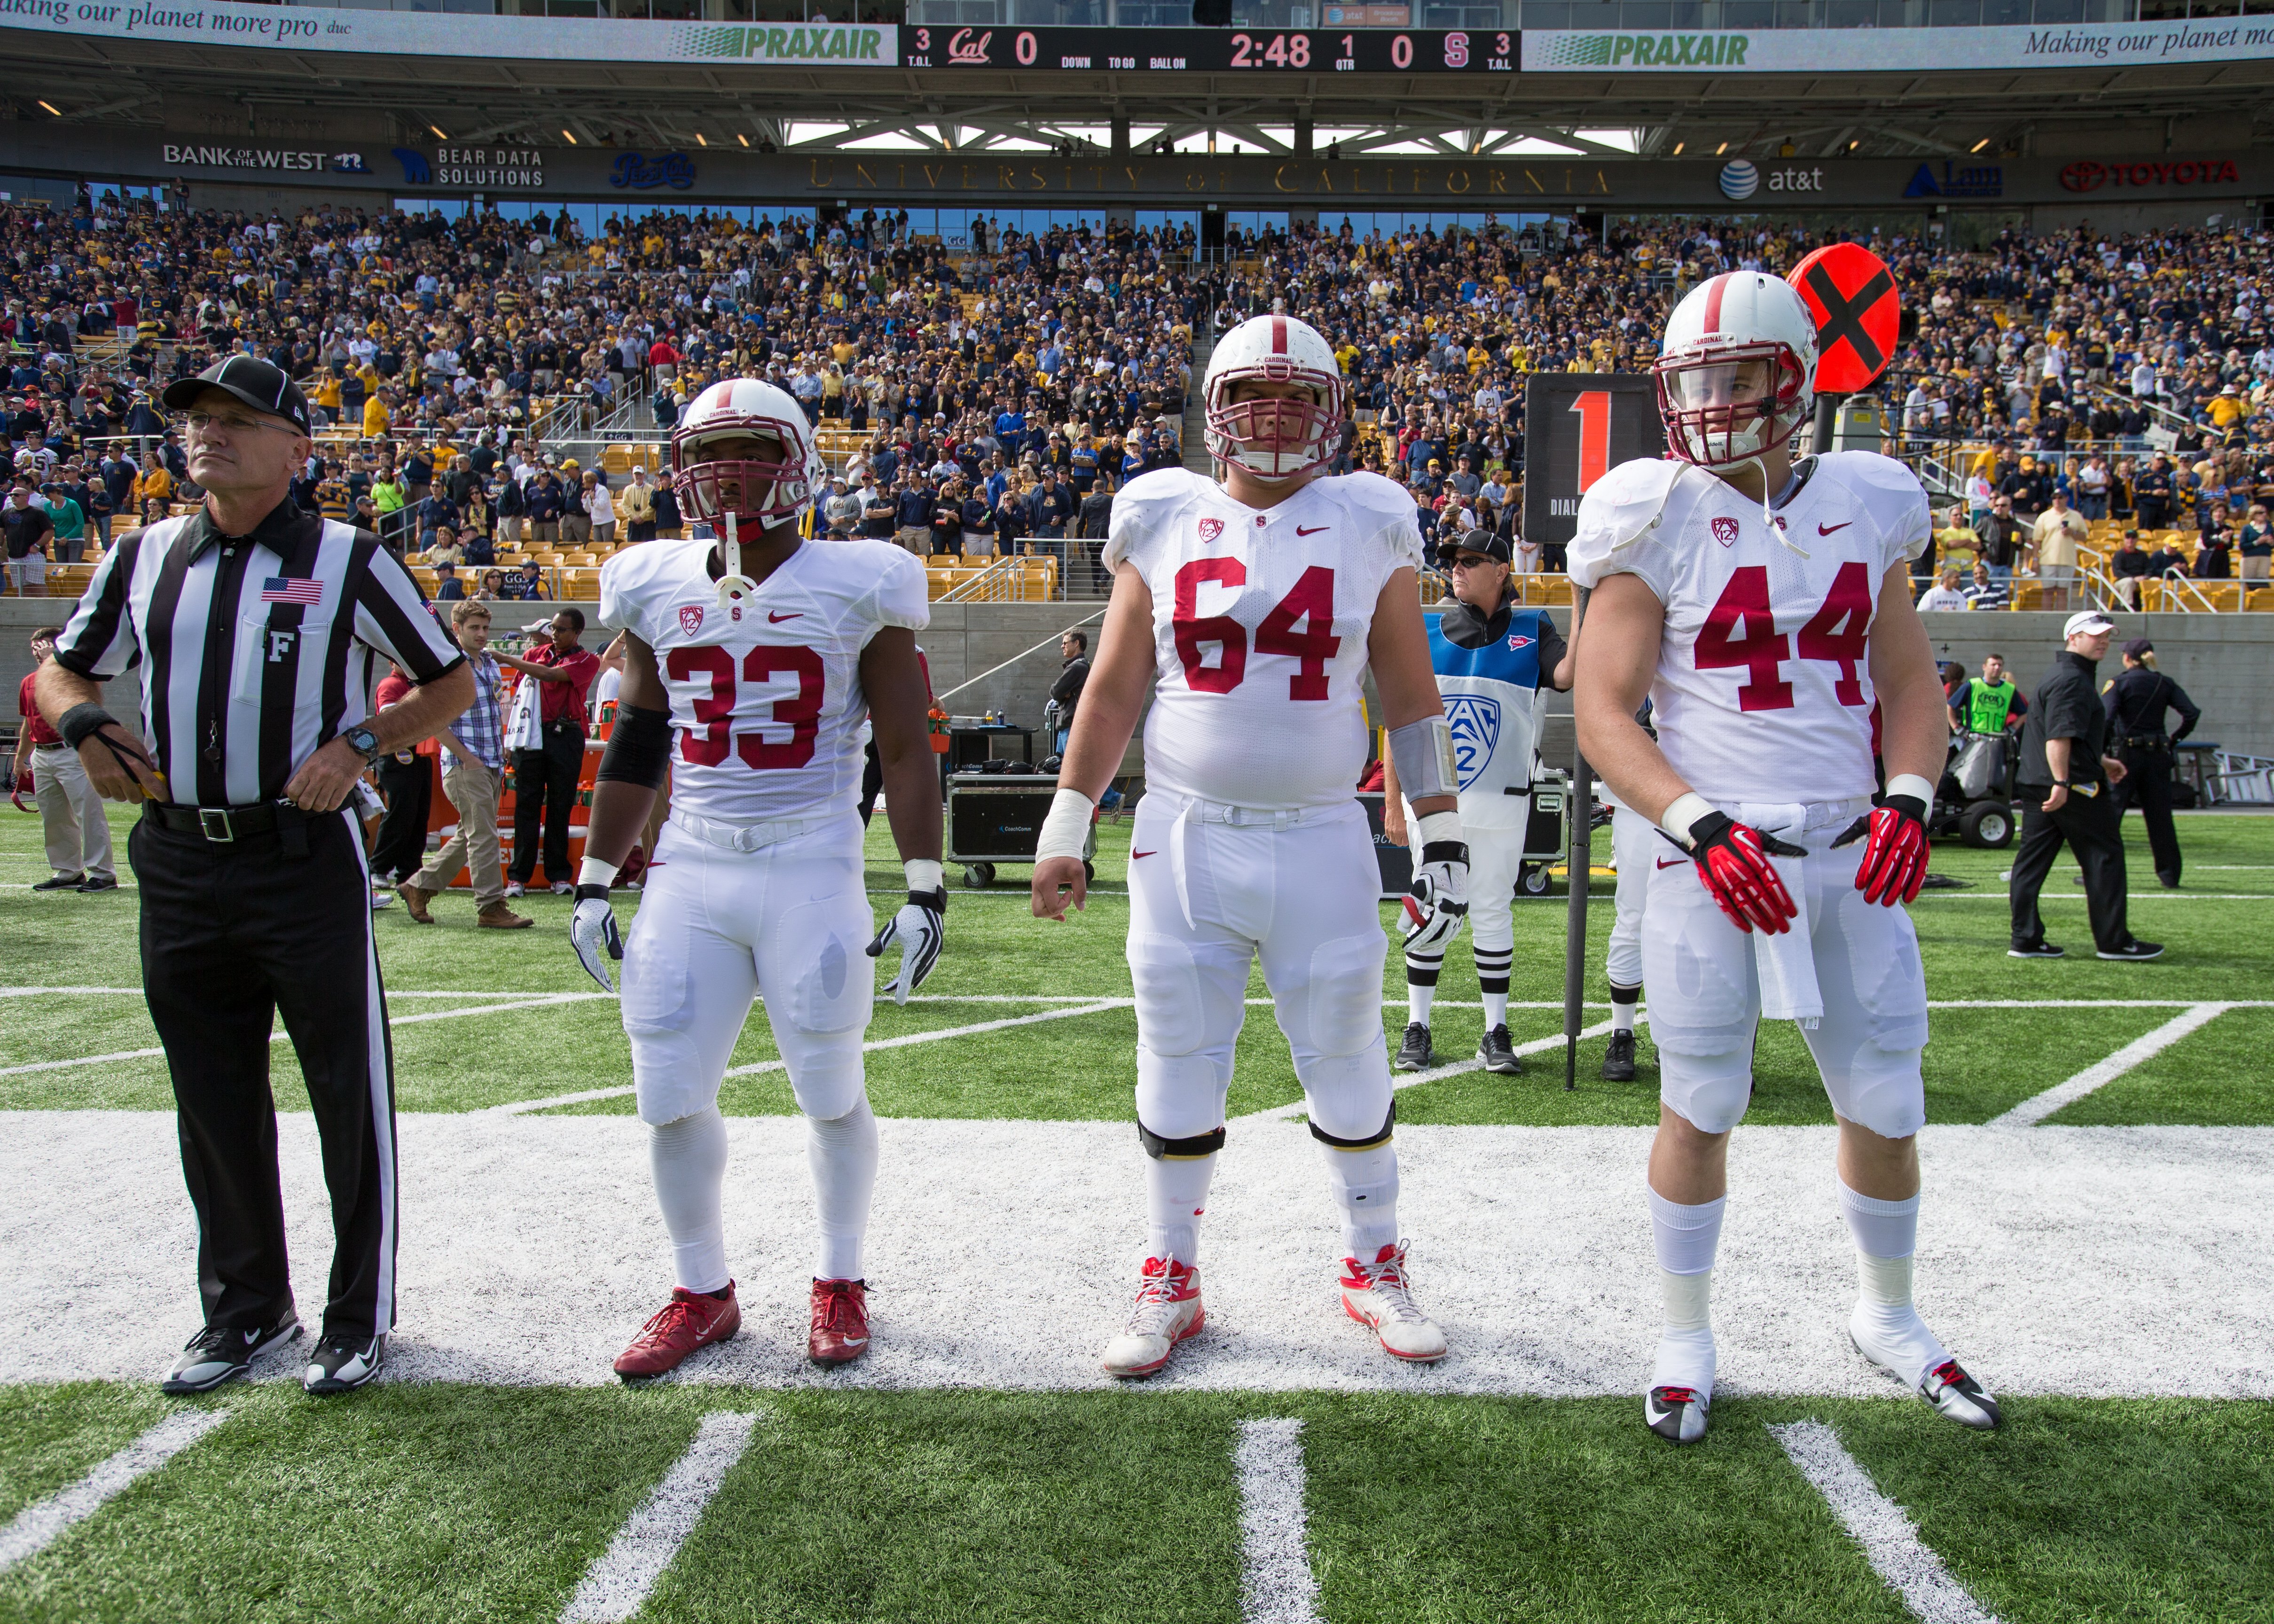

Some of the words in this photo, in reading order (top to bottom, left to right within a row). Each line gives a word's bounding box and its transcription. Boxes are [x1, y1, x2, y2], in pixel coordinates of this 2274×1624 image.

[0, 0, 69, 24] aking
[77, 4, 121, 22] our
[125, 1, 204, 30] planet
[212, 15, 271, 33] more
[275, 19, 318, 41] pro
[327, 22, 352, 34] duc
[745, 28, 882, 59] PRAXAIR
[917, 29, 931, 50] 3
[948, 28, 992, 64] Cal
[1016, 31, 1037, 65] 0
[1341, 35, 1353, 57] 1
[1444, 32, 1469, 68] S
[1496, 34, 1510, 55] 3
[1612, 35, 1749, 65] PRAXAIR
[2024, 30, 2111, 59] Making
[2117, 33, 2160, 51] our
[2160, 25, 2239, 56] planet
[1230, 34, 1311, 68] 2:48
[1392, 35, 1413, 69] 0
[1062, 57, 1091, 69] DOWN
[1108, 57, 1121, 69] TO
[1122, 57, 1135, 69] GO
[1150, 57, 1171, 70] BALL
[1172, 58, 1186, 70] ON
[1336, 59, 1355, 71] QTR
[164, 144, 234, 165] BANK
[233, 158, 257, 168] THE
[237, 149, 252, 158] OF
[256, 149, 327, 171] WEST
[439, 148, 486, 164] BEAR
[496, 150, 543, 166] DATA
[439, 168, 543, 186] SOLUTIONS
[810, 158, 1144, 190] UNIVERSITY
[1274, 164, 1609, 193] CALIFORNIA
[1768, 167, 1823, 191] at&t
[1945, 161, 2002, 186] Lam
[2111, 161, 2240, 186] TOYOTA
[948, 237, 966, 246] GG
[751, 345, 761, 355] Cal
[1693, 336, 1723, 345] CARDINAL
[709, 409, 737, 418] CARDINAL
[1485, 398, 1495, 408] 21
[1568, 391, 1611, 495] 1
[833, 500, 846, 509] Cal
[1551, 499, 1577, 515] DIAL
[1199, 518, 1224, 534] PAC
[1255, 515, 1266, 528] S
[1711, 517, 1738, 535] PAC
[1202, 528, 1215, 538] 12
[1720, 530, 1733, 540] 12
[680, 606, 703, 626] PAC
[685, 618, 697, 629] 12
[731, 607, 742, 621] S
[1172, 556, 1341, 701] 64
[1694, 562, 1869, 712] 44
[269, 631, 295, 662] F
[666, 645, 825, 770] 33
[506, 726, 525, 735] RADE
[1443, 700, 1498, 751] AC
[1457, 746, 1477, 772] 2
